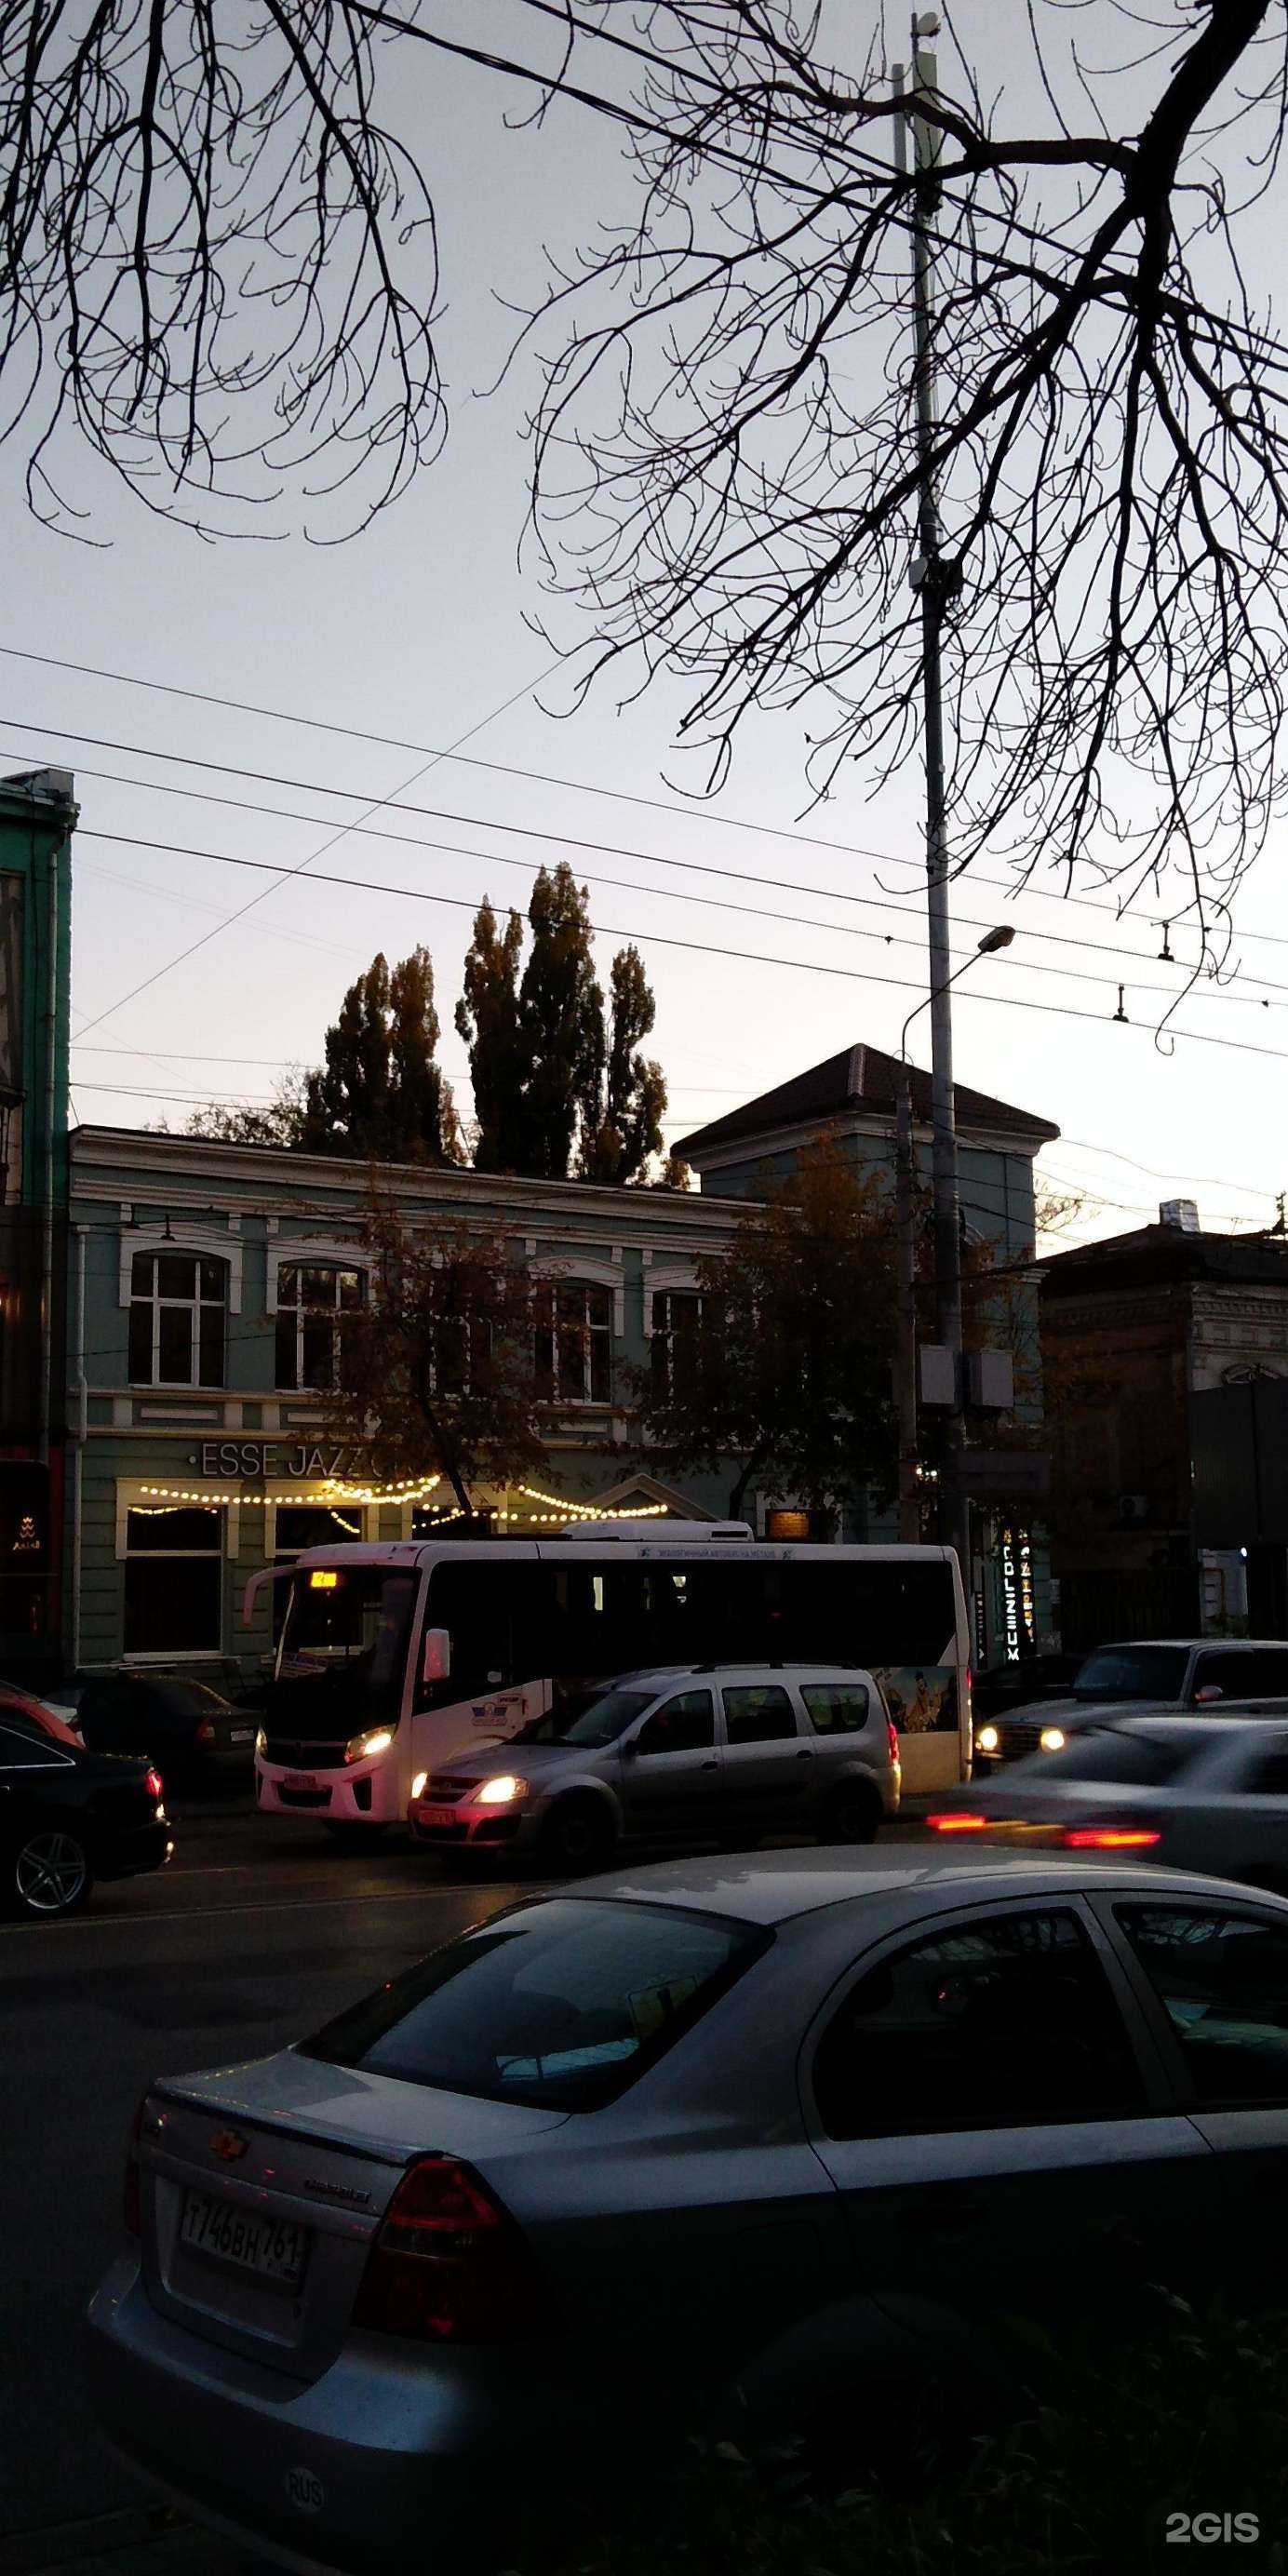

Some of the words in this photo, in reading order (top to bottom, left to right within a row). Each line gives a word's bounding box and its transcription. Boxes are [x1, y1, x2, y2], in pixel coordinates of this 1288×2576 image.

[201, 1443, 277, 1476] ESSE
[288, 1445, 364, 1477] JAZZ
[289, 2474, 322, 2506] RUS
